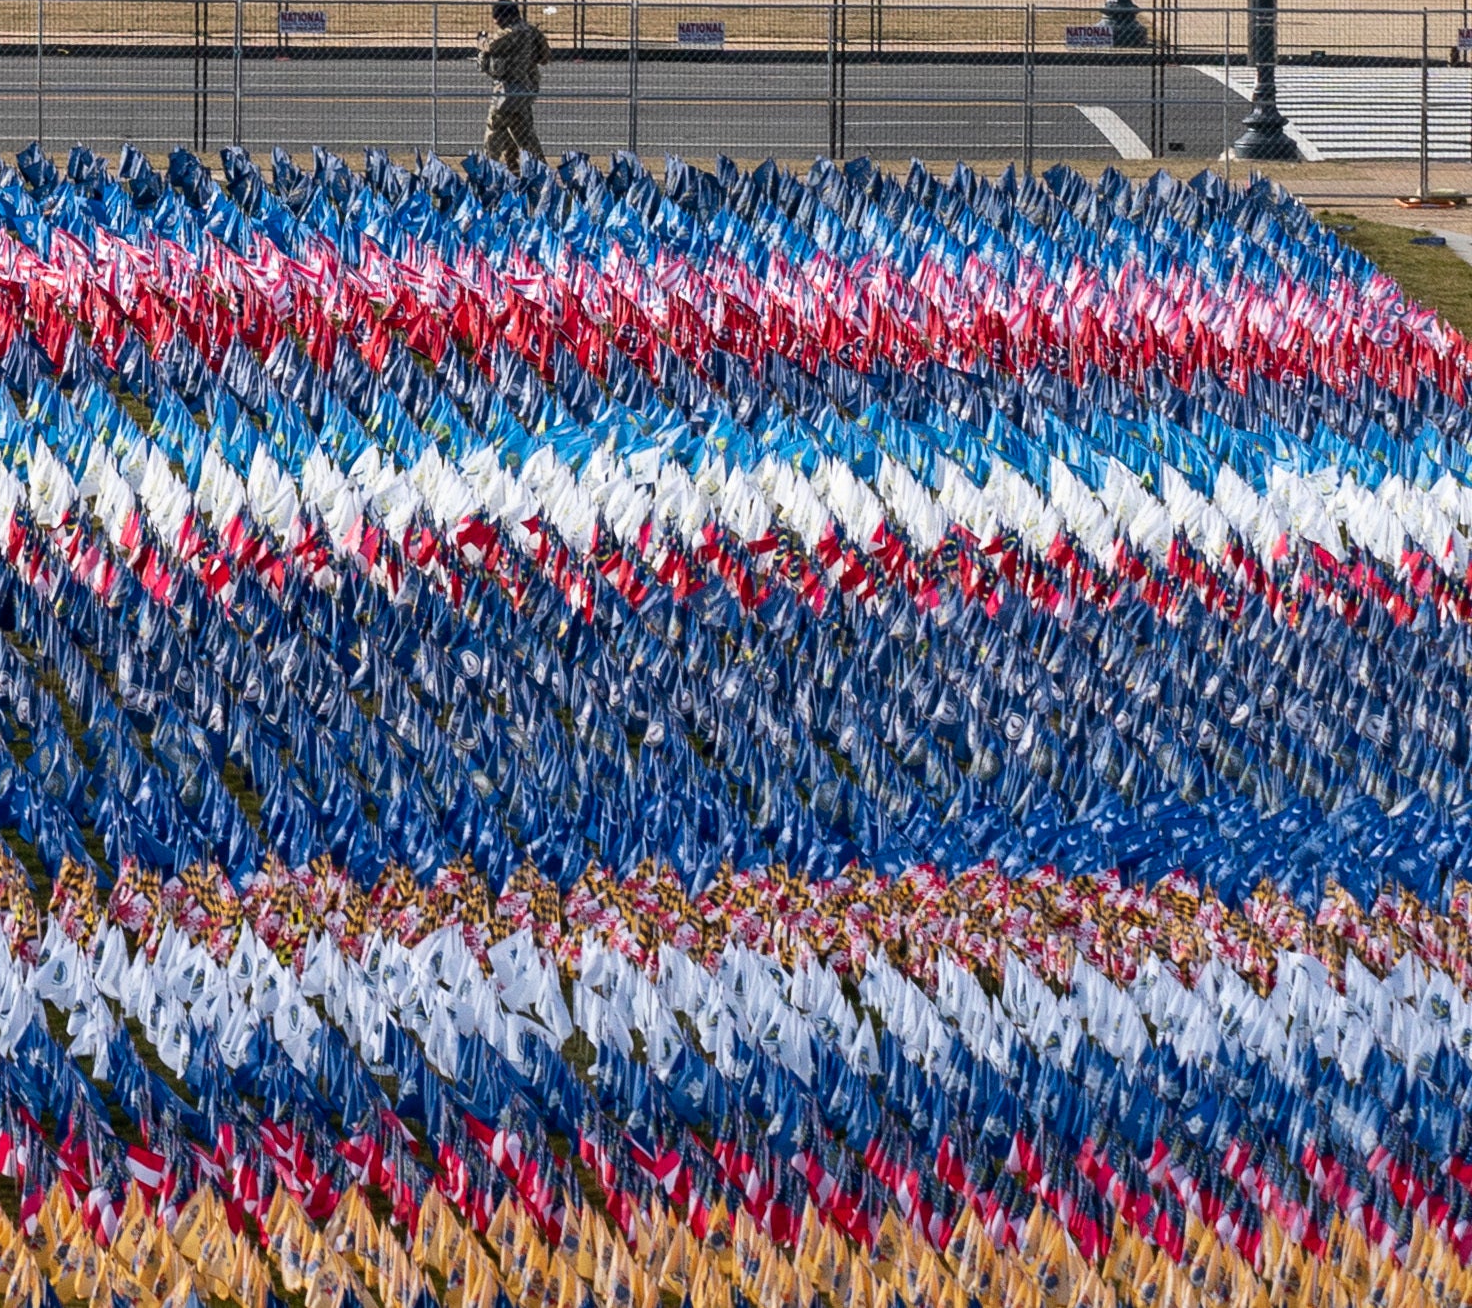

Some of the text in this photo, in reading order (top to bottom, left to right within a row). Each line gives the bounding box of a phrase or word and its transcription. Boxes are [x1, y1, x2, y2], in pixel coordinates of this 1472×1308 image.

[280, 12, 325, 22] NATIONAL
[679, 22, 723, 32] NATIONAL
[1066, 27, 1111, 36] NATIONAL
